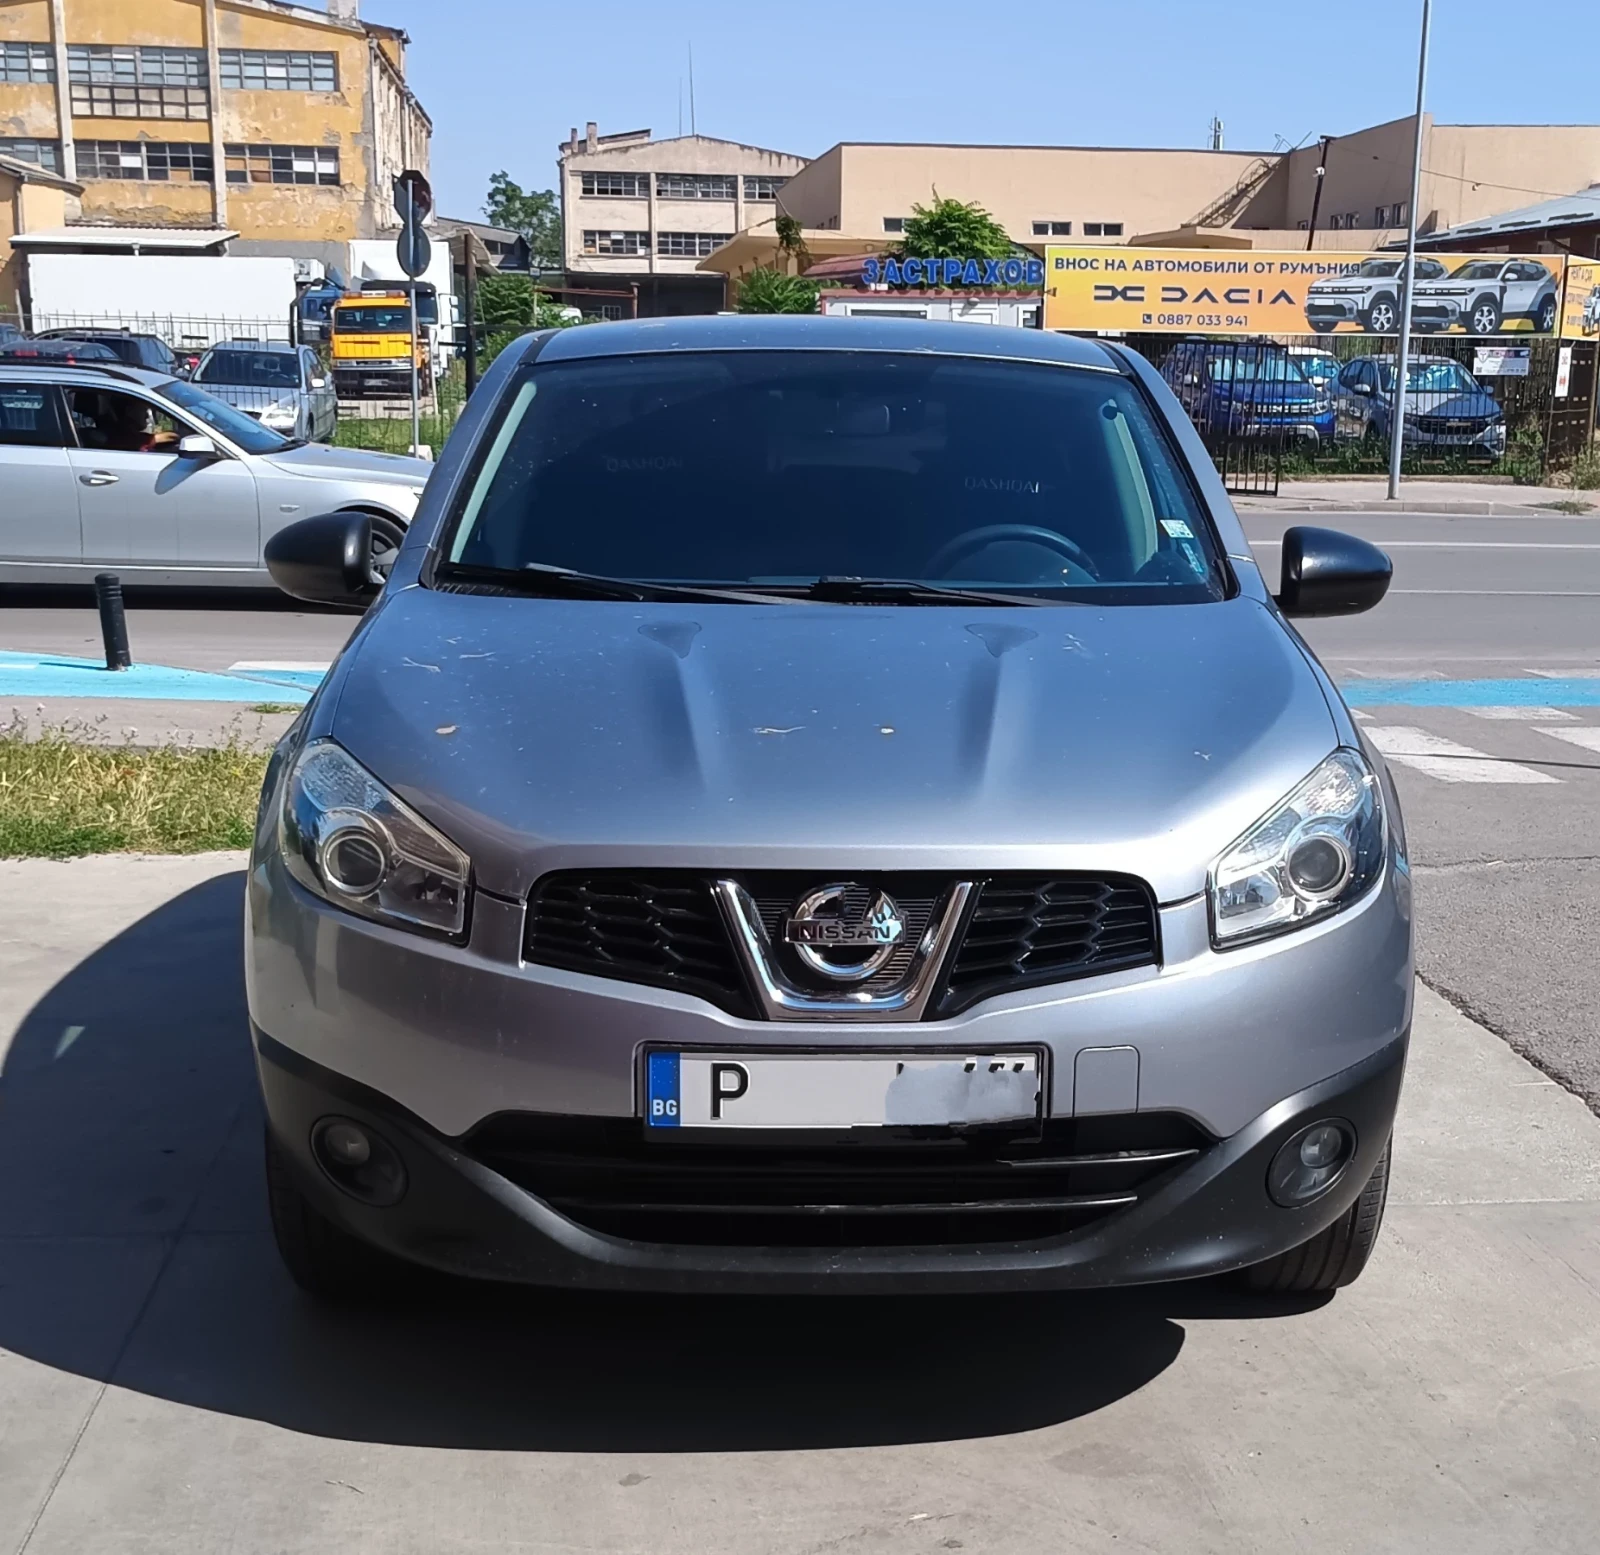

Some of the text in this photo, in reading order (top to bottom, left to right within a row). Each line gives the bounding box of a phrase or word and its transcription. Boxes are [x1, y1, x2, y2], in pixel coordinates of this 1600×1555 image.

[1055, 257, 1360, 275] ВНОС НА АВТОМОБИЛИ ОТ РУМЪНИЯ
[1161, 287, 1296, 305] DACIA
[1157, 314, 1248, 327] 0887 033 941
[798, 925, 890, 939] NISSAN
[652, 1099, 678, 1116] BG
